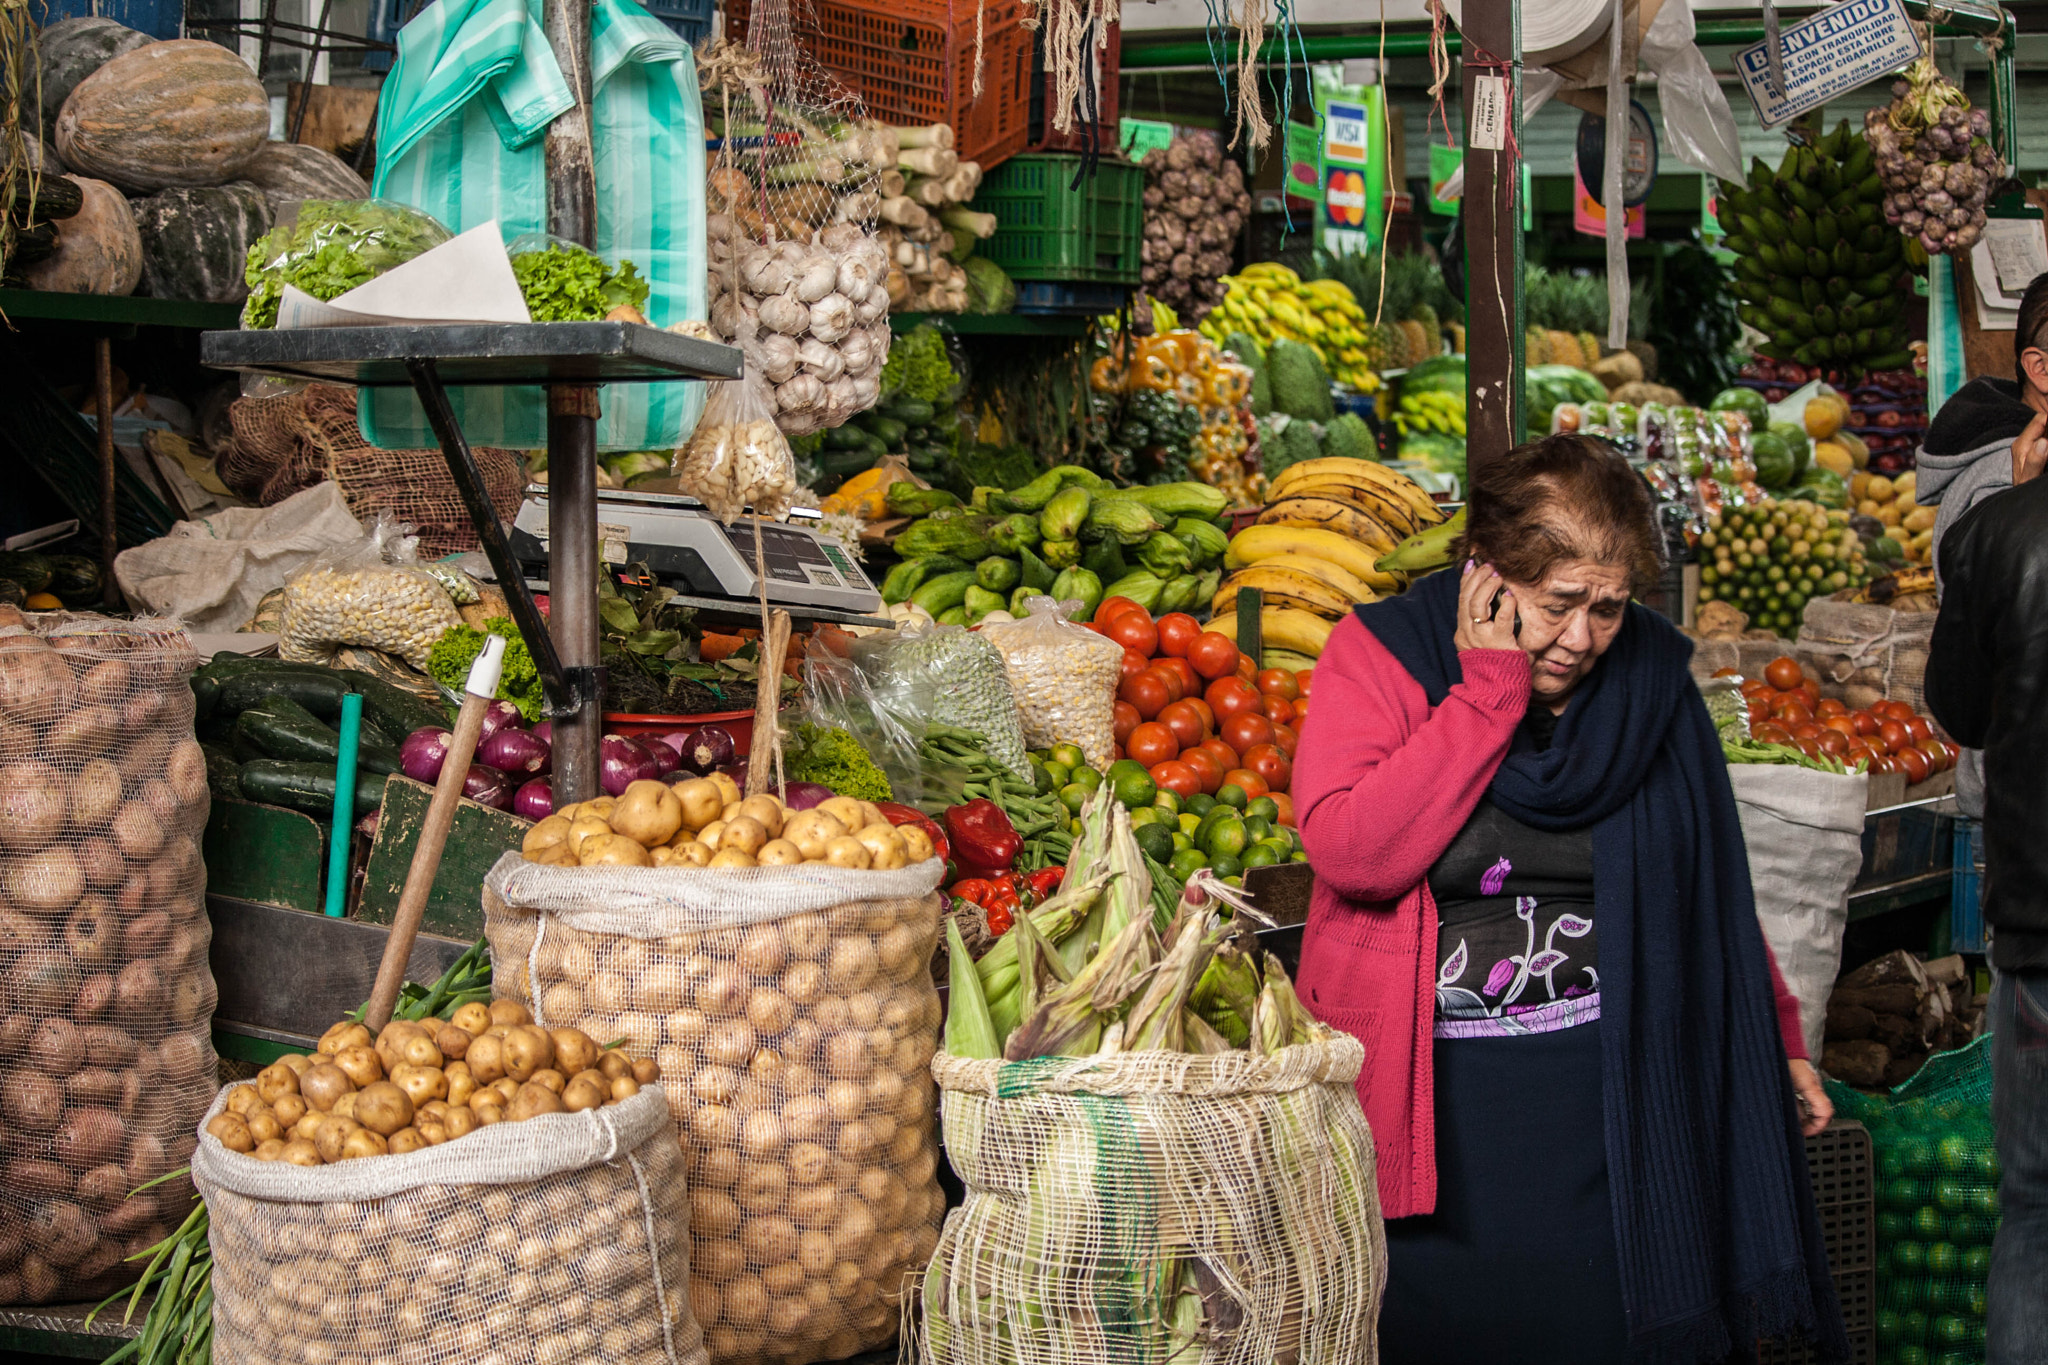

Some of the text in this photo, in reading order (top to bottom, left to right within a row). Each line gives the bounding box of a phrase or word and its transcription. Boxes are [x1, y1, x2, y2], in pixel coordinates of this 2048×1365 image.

[1750, 0, 1885, 69] BENVENIDO
[1790, 51, 1835, 77] ESPACIO
[1837, 39, 1862, 55] ESTA
[1864, 23, 1894, 43] LIBRE
[1751, 59, 1794, 85] RESRE
[1796, 47, 1819, 63] CON
[1773, 93, 1818, 118] MINISTERIO
[1820, 87, 1830, 96] DE
[1882, 51, 1909, 67] SOCIAL
[1785, 71, 1816, 91] HUMO
[1818, 63, 1833, 75] DE
[1835, 34, 1895, 68] CIGARRILLO
[1837, 72, 1848, 81] DE
[1896, 43, 1910, 54] DEL
[1335, 122, 1360, 142] VISA
